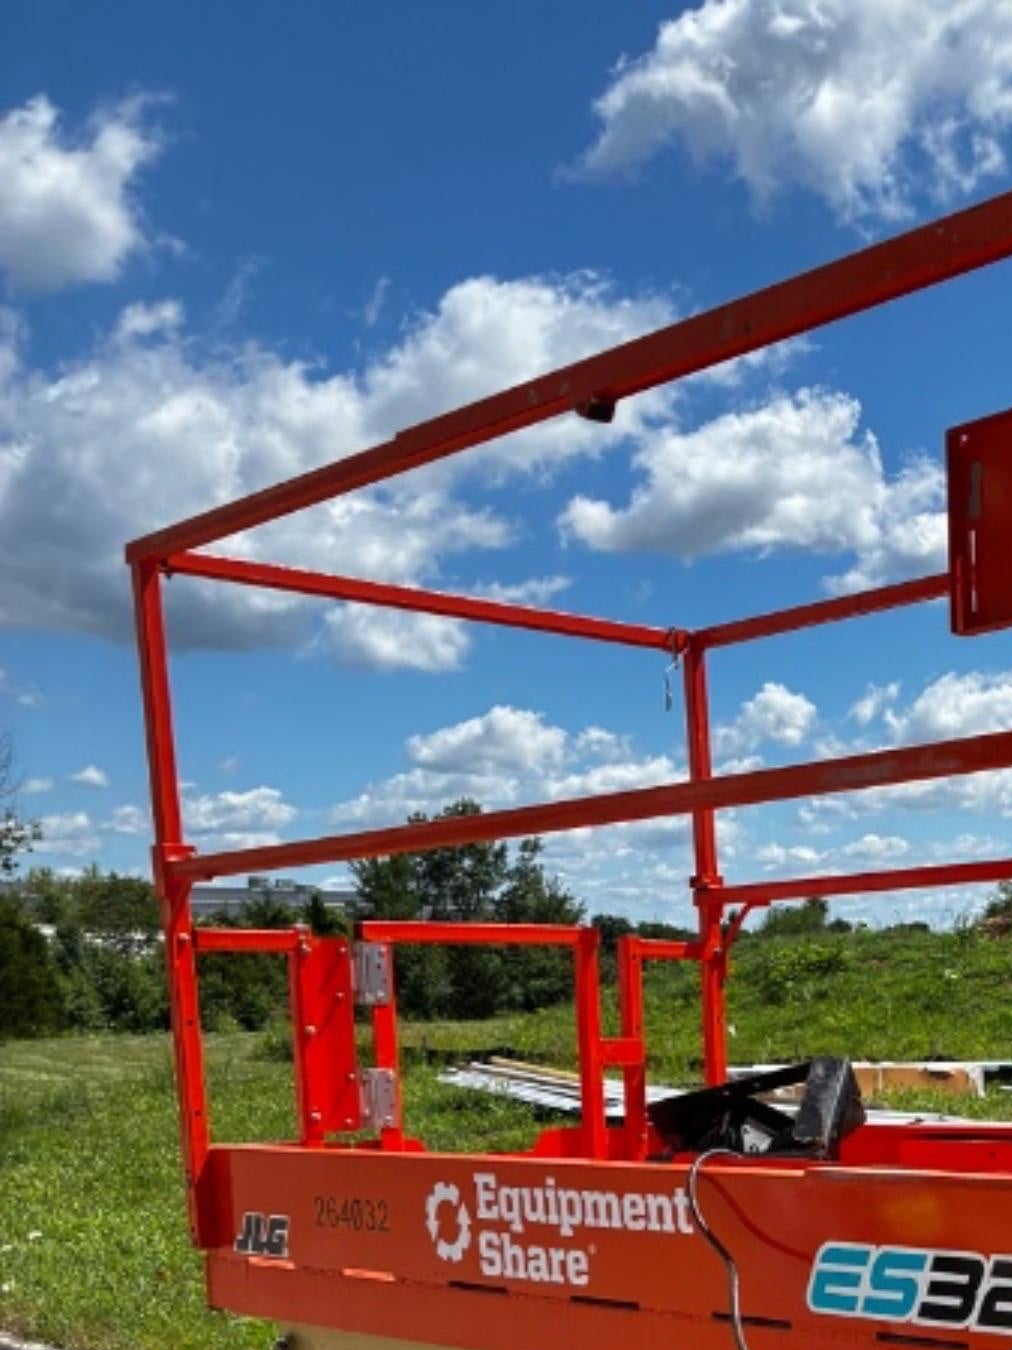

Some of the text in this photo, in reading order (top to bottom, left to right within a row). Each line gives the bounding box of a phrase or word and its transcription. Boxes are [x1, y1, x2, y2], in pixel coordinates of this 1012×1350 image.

[314, 1195, 391, 1232] 264032
[473, 1172, 694, 1237] Equipment
[233, 1211, 290, 1258] JLG
[479, 1229, 589, 1286] Share
